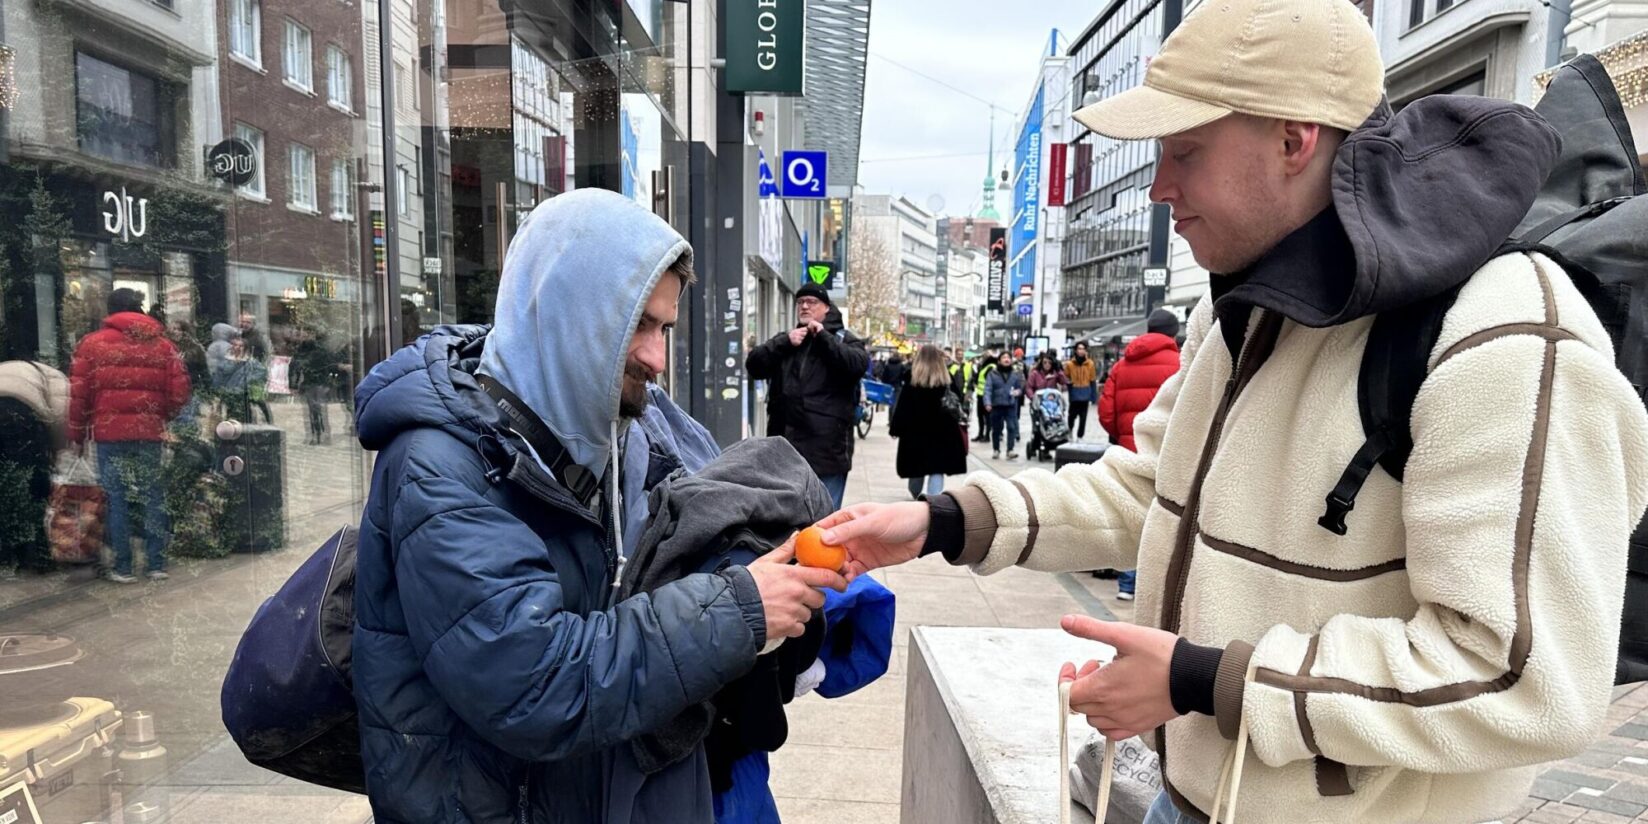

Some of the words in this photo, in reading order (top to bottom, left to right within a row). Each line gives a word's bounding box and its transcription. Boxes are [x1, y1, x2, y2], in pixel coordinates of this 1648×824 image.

[1025, 132, 1040, 202] Nachrichten
[1023, 204, 1036, 231] Ruhr
[989, 260, 1003, 301] SATURN
[1119, 742, 1147, 765] ICH
